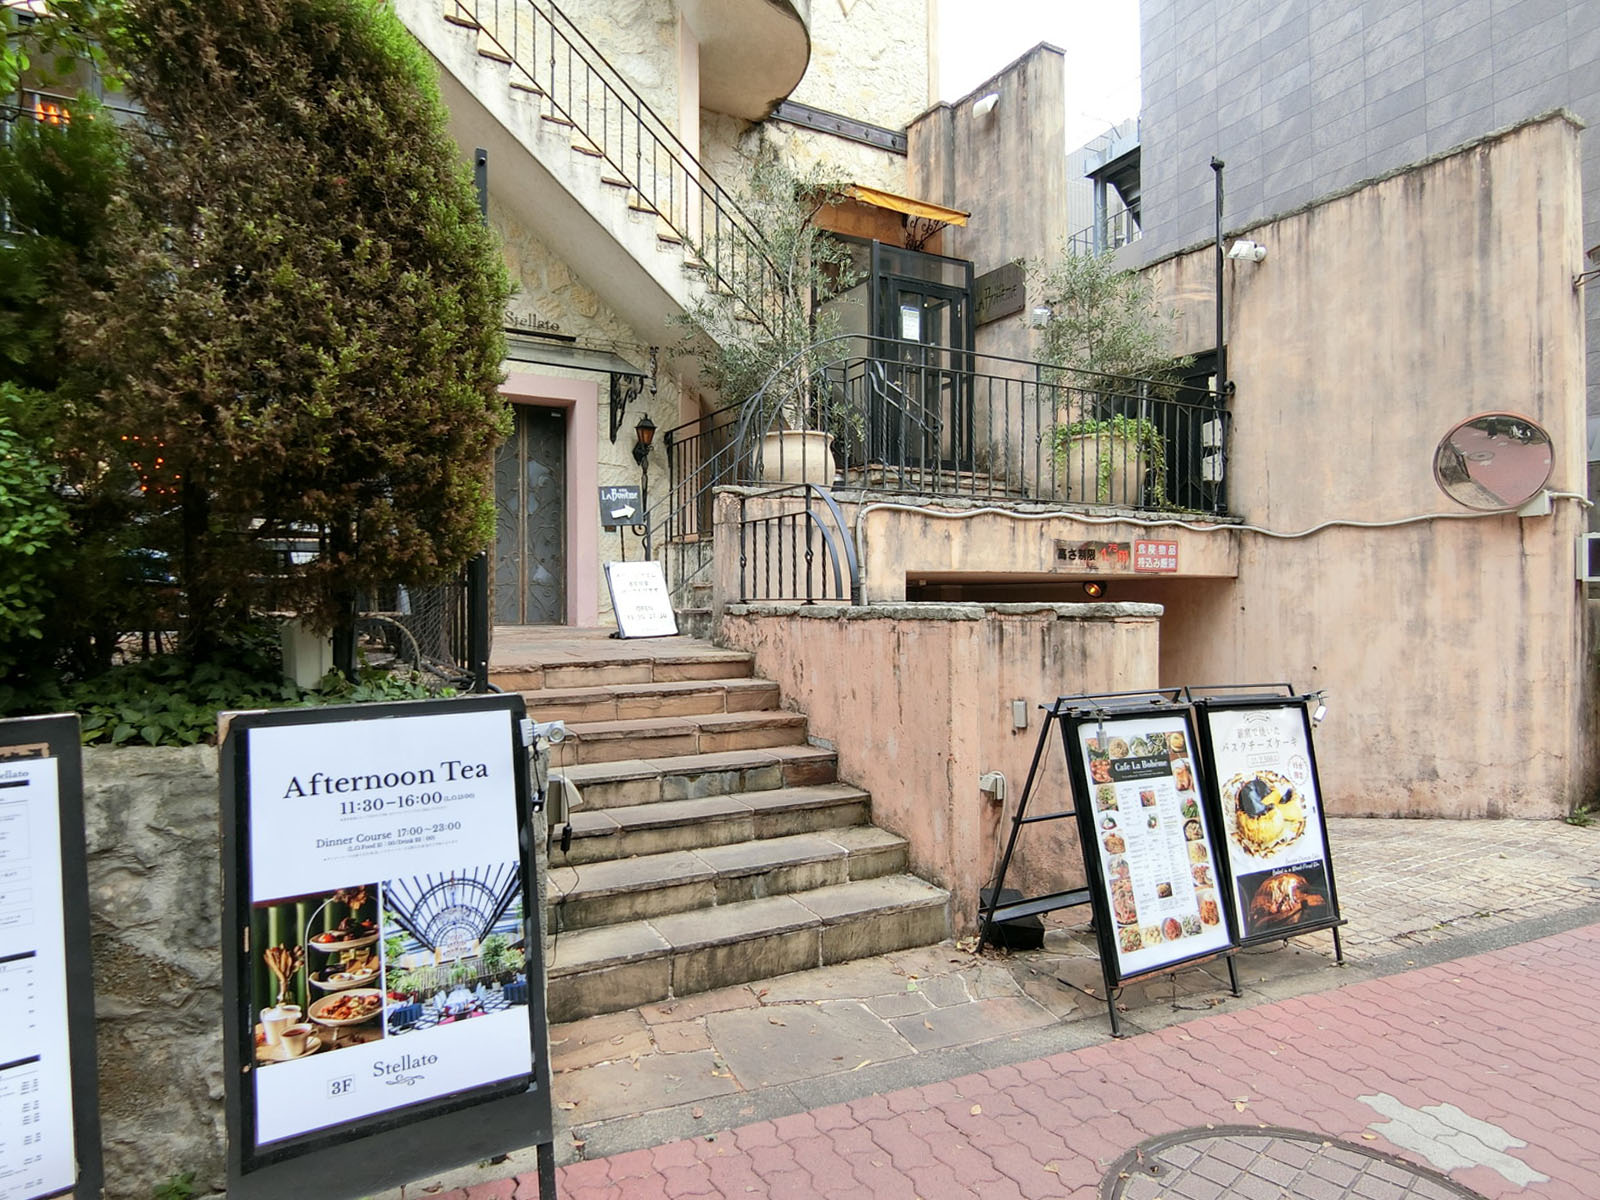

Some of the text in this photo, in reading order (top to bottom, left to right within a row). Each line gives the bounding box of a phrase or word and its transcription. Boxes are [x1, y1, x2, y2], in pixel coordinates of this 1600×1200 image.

[505, 310, 560, 332] Stellato
[1057, 548, 1096, 561] 高さ制限
[283, 760, 489, 799] Afternoon Tea
[340, 791, 443, 815] 11:30-16:00
[316, 837, 353, 849] Dinner
[356, 831, 392, 843] Course
[331, 1054, 438, 1095] 3F Stellato
